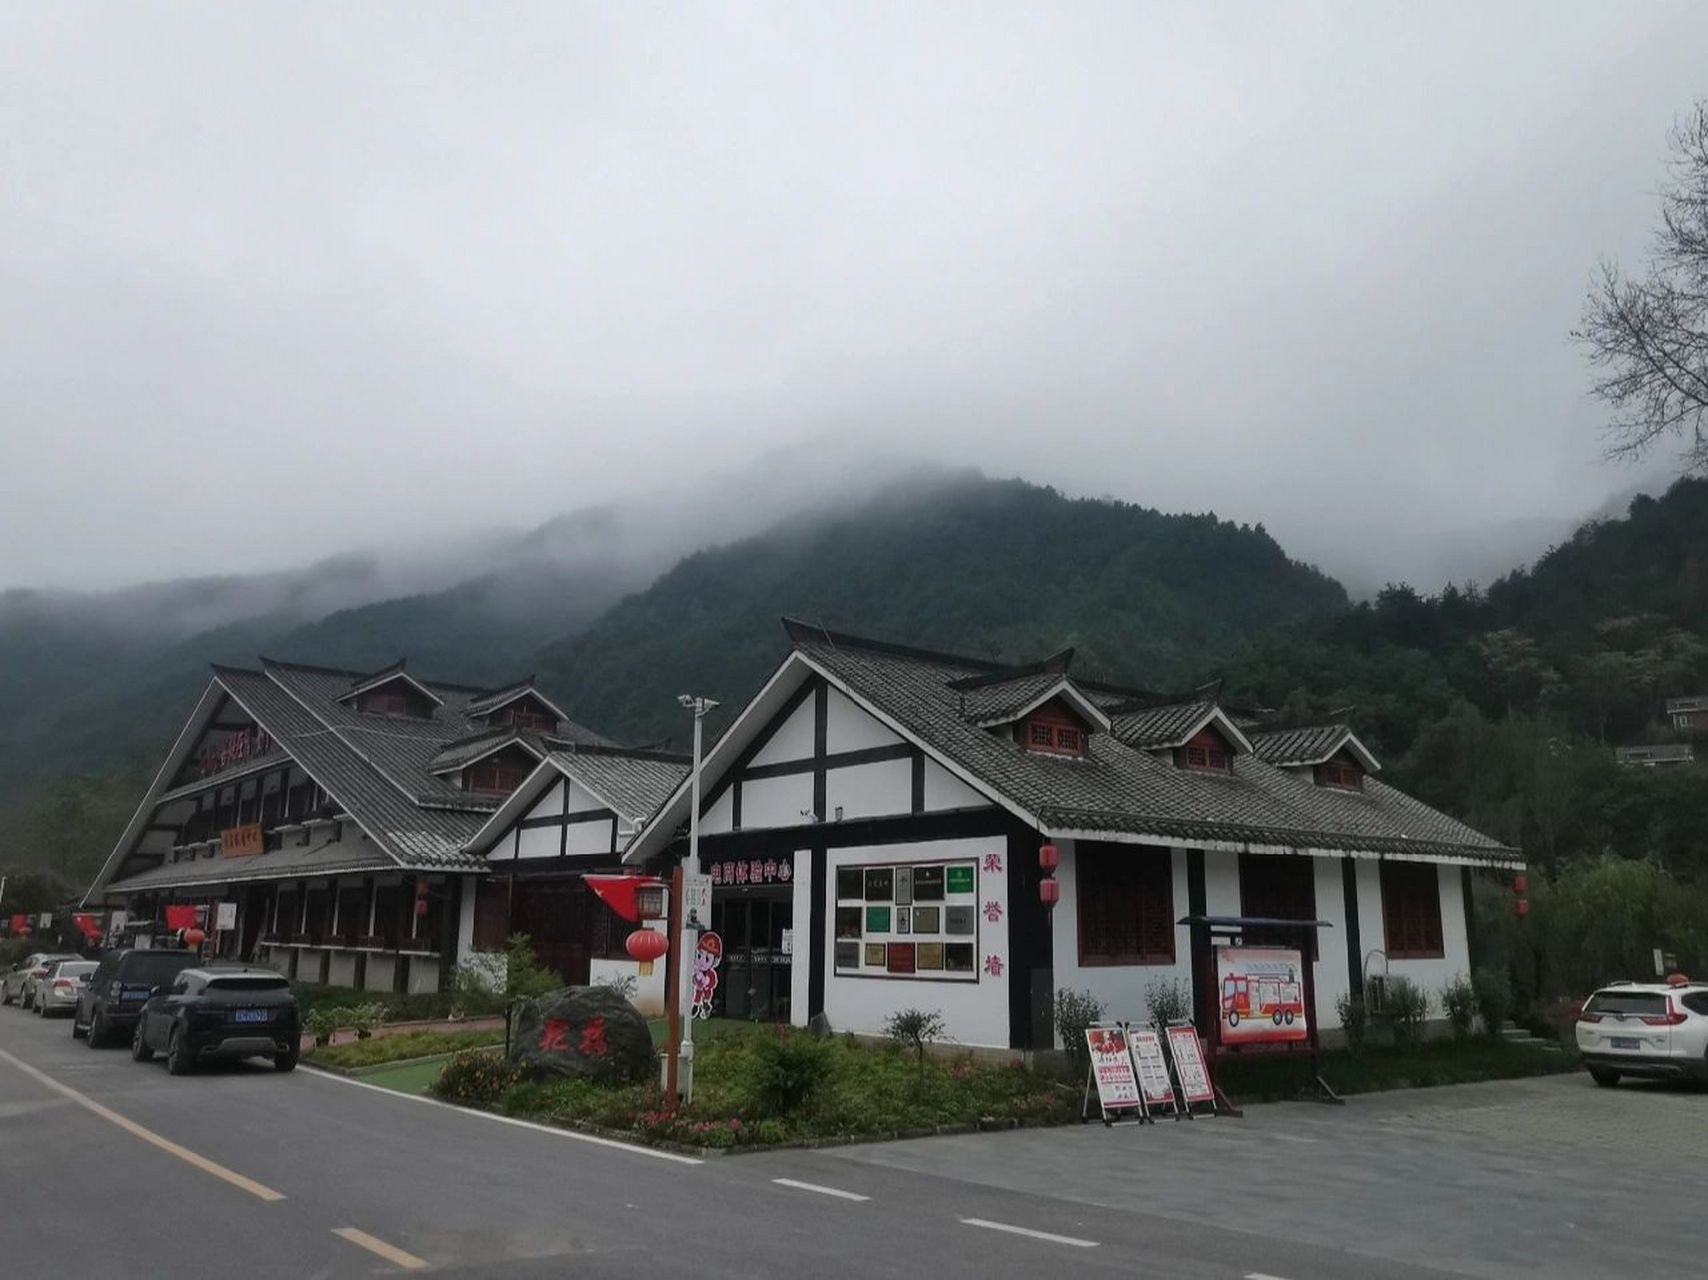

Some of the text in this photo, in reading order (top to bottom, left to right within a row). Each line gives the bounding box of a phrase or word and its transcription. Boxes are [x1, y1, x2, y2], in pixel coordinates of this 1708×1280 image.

[711, 858, 791, 885] 电商体验中心
[983, 854, 1004, 977] 荣誉墙
